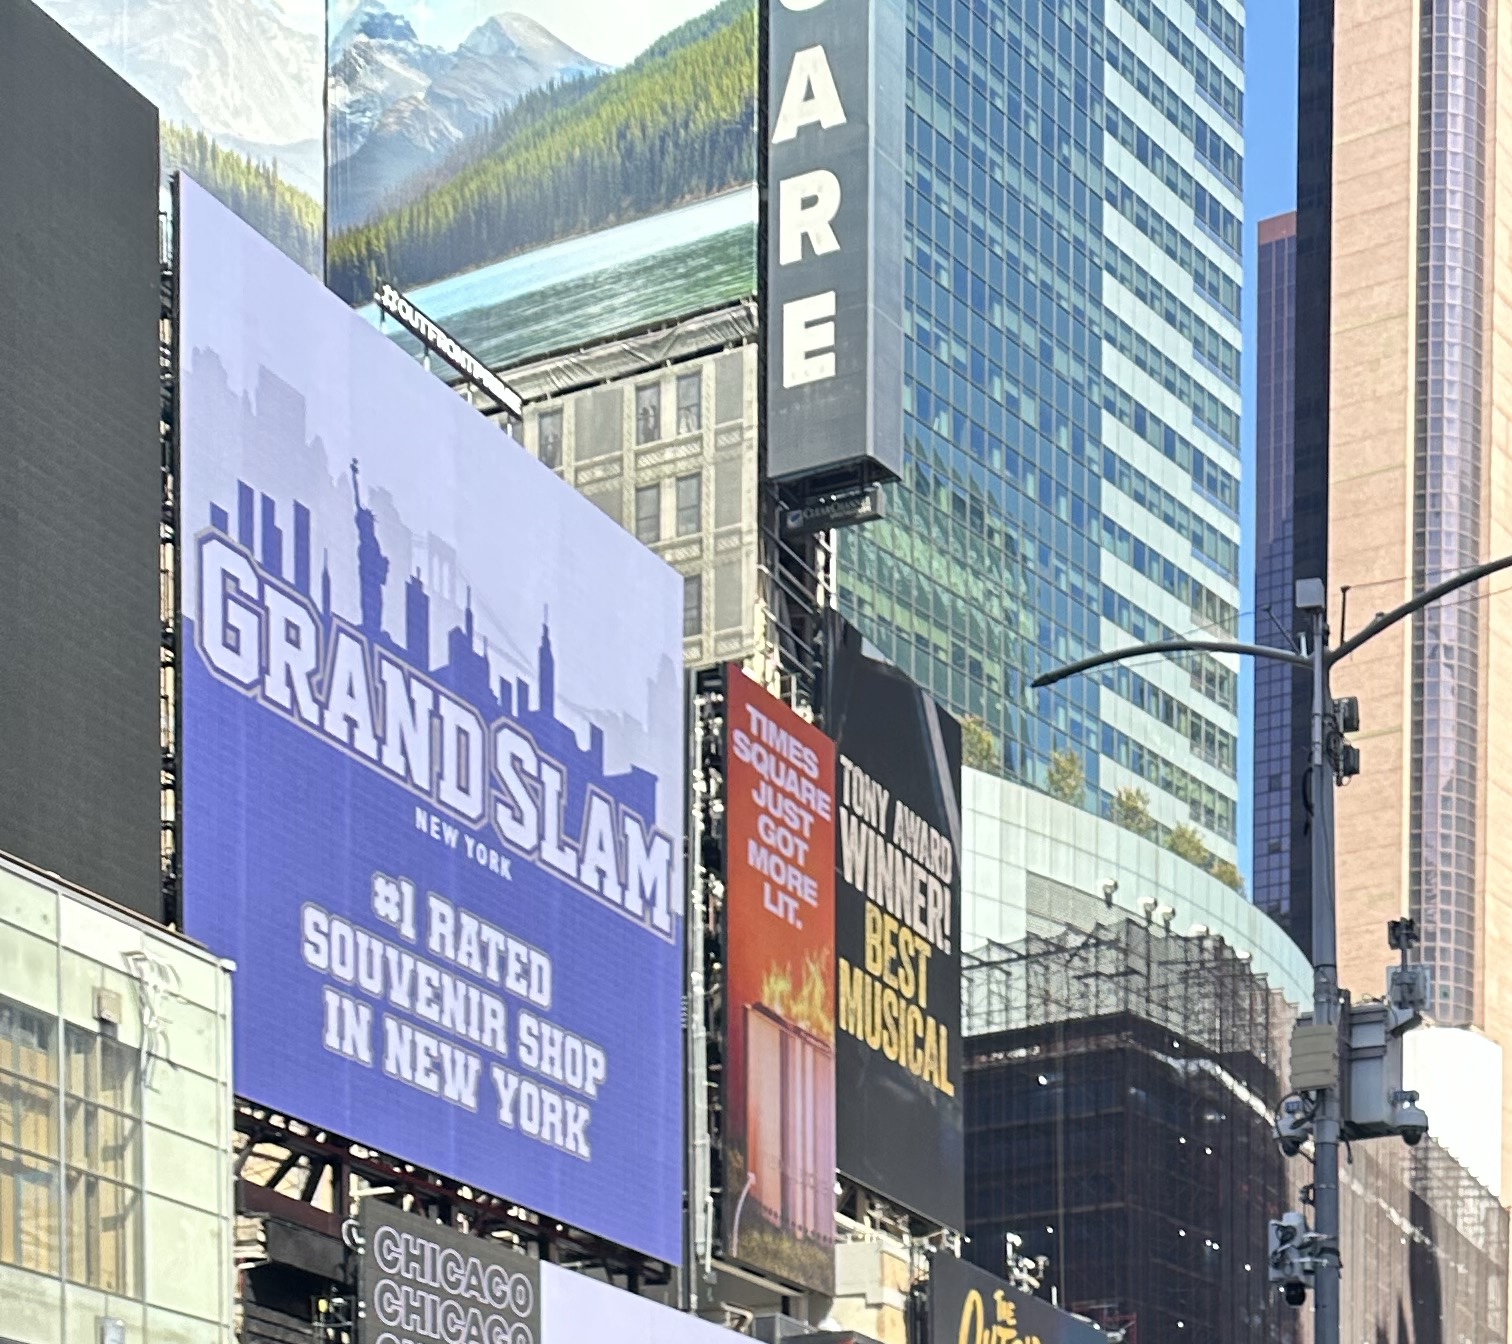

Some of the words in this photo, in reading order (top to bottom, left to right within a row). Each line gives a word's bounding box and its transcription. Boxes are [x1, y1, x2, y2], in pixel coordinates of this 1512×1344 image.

[197, 529, 488, 827] GRAND
[733, 729, 831, 821] SQUARE
[745, 703, 819, 779] TIMES
[414, 807, 459, 850] NEW
[464, 831, 513, 881] YORK
[492, 718, 675, 938] SLAM
[752, 779, 814, 837] JUST
[757, 813, 809, 865] GOT
[839, 755, 890, 836] TONY
[893, 800, 953, 884] AWARD
[747, 847, 818, 906] MORE
[762, 882, 802, 929] LIT.
[839, 806, 952, 955] WINNER!
[371, 872, 417, 941] #1
[427, 893, 552, 1008] RATED
[862, 901, 932, 1006] BEST
[301, 902, 508, 1056] SOUVENIR
[518, 1009, 606, 1099] SHOP
[838, 959, 955, 1097] MUSICAL
[323, 985, 373, 1066] IN
[383, 1012, 481, 1111] NEW
[491, 1065, 591, 1161] YORK
[374, 1225, 534, 1317] CHICAGO
